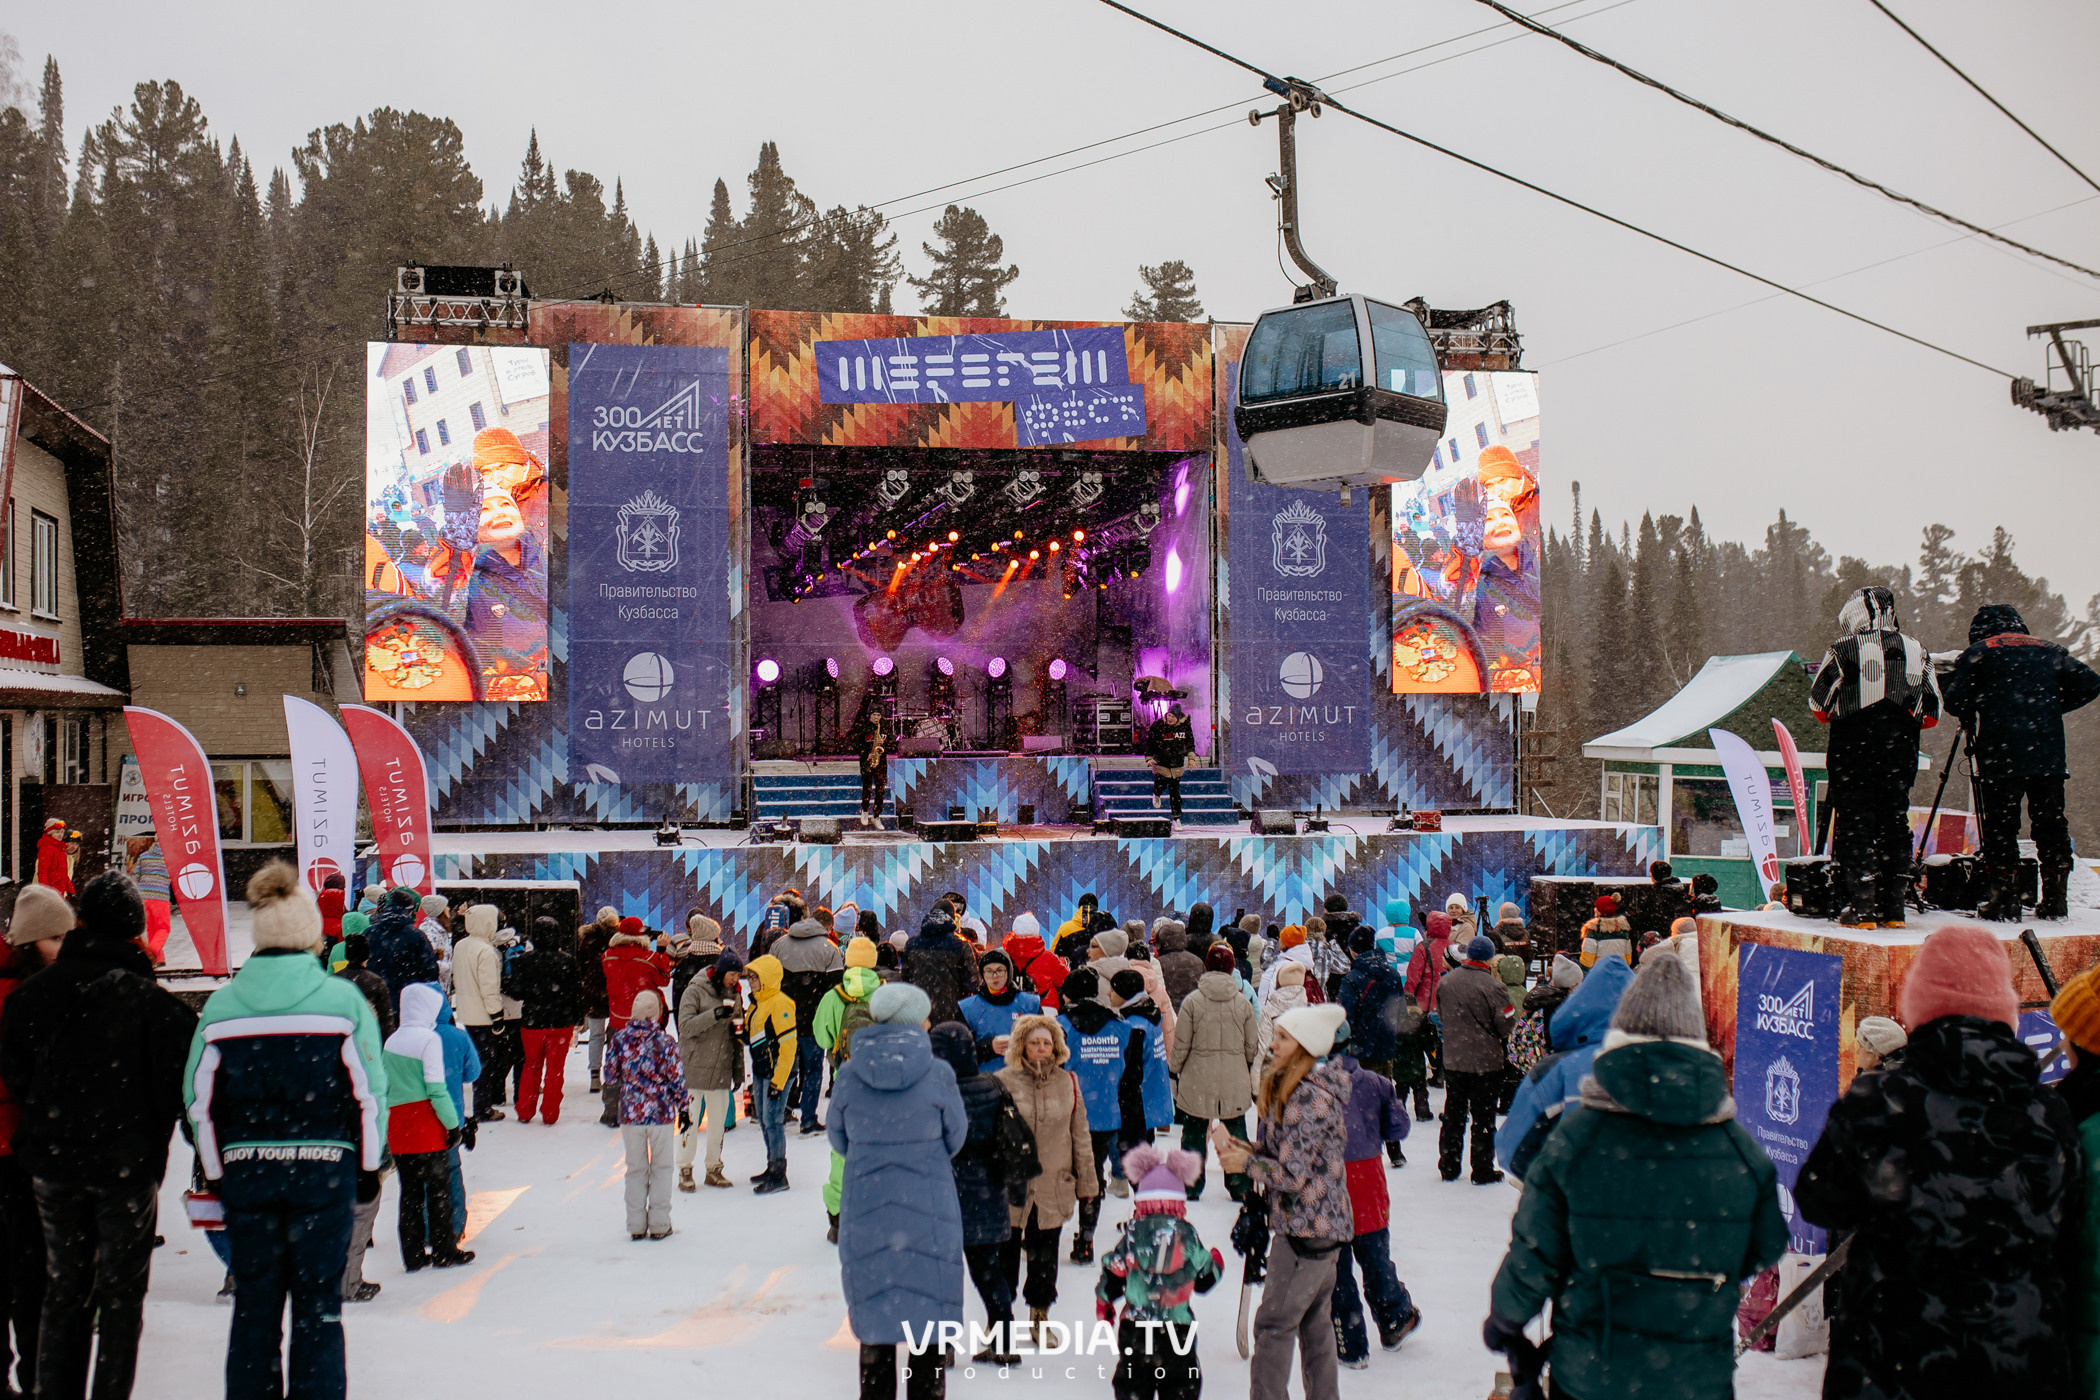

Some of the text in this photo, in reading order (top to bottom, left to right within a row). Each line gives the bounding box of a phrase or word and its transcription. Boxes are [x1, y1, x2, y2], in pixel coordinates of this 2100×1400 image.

[1338, 371, 1356, 390] 21
[592, 405, 642, 428] 300
[592, 430, 704, 454] КУЗБАСС
[599, 583, 697, 600] Правительство
[1257, 586, 1343, 604] Правительство
[618, 604, 679, 621] Кузбасса
[1274, 606, 1326, 623] Кузбасса
[622, 736, 675, 749] HOTELS
[1279, 730, 1325, 743] HOTELS
[1757, 993, 1783, 1014] 300
[1757, 1012, 1815, 1040] КУЗБАСС
[1081, 1035, 1119, 1046] ВОЛОНТЁР
[1757, 1125, 1809, 1151] Правительство
[223, 1148, 256, 1165] ENJOY
[257, 1147, 297, 1161] YOUR
[1765, 1145, 1798, 1165] Кузбасса
